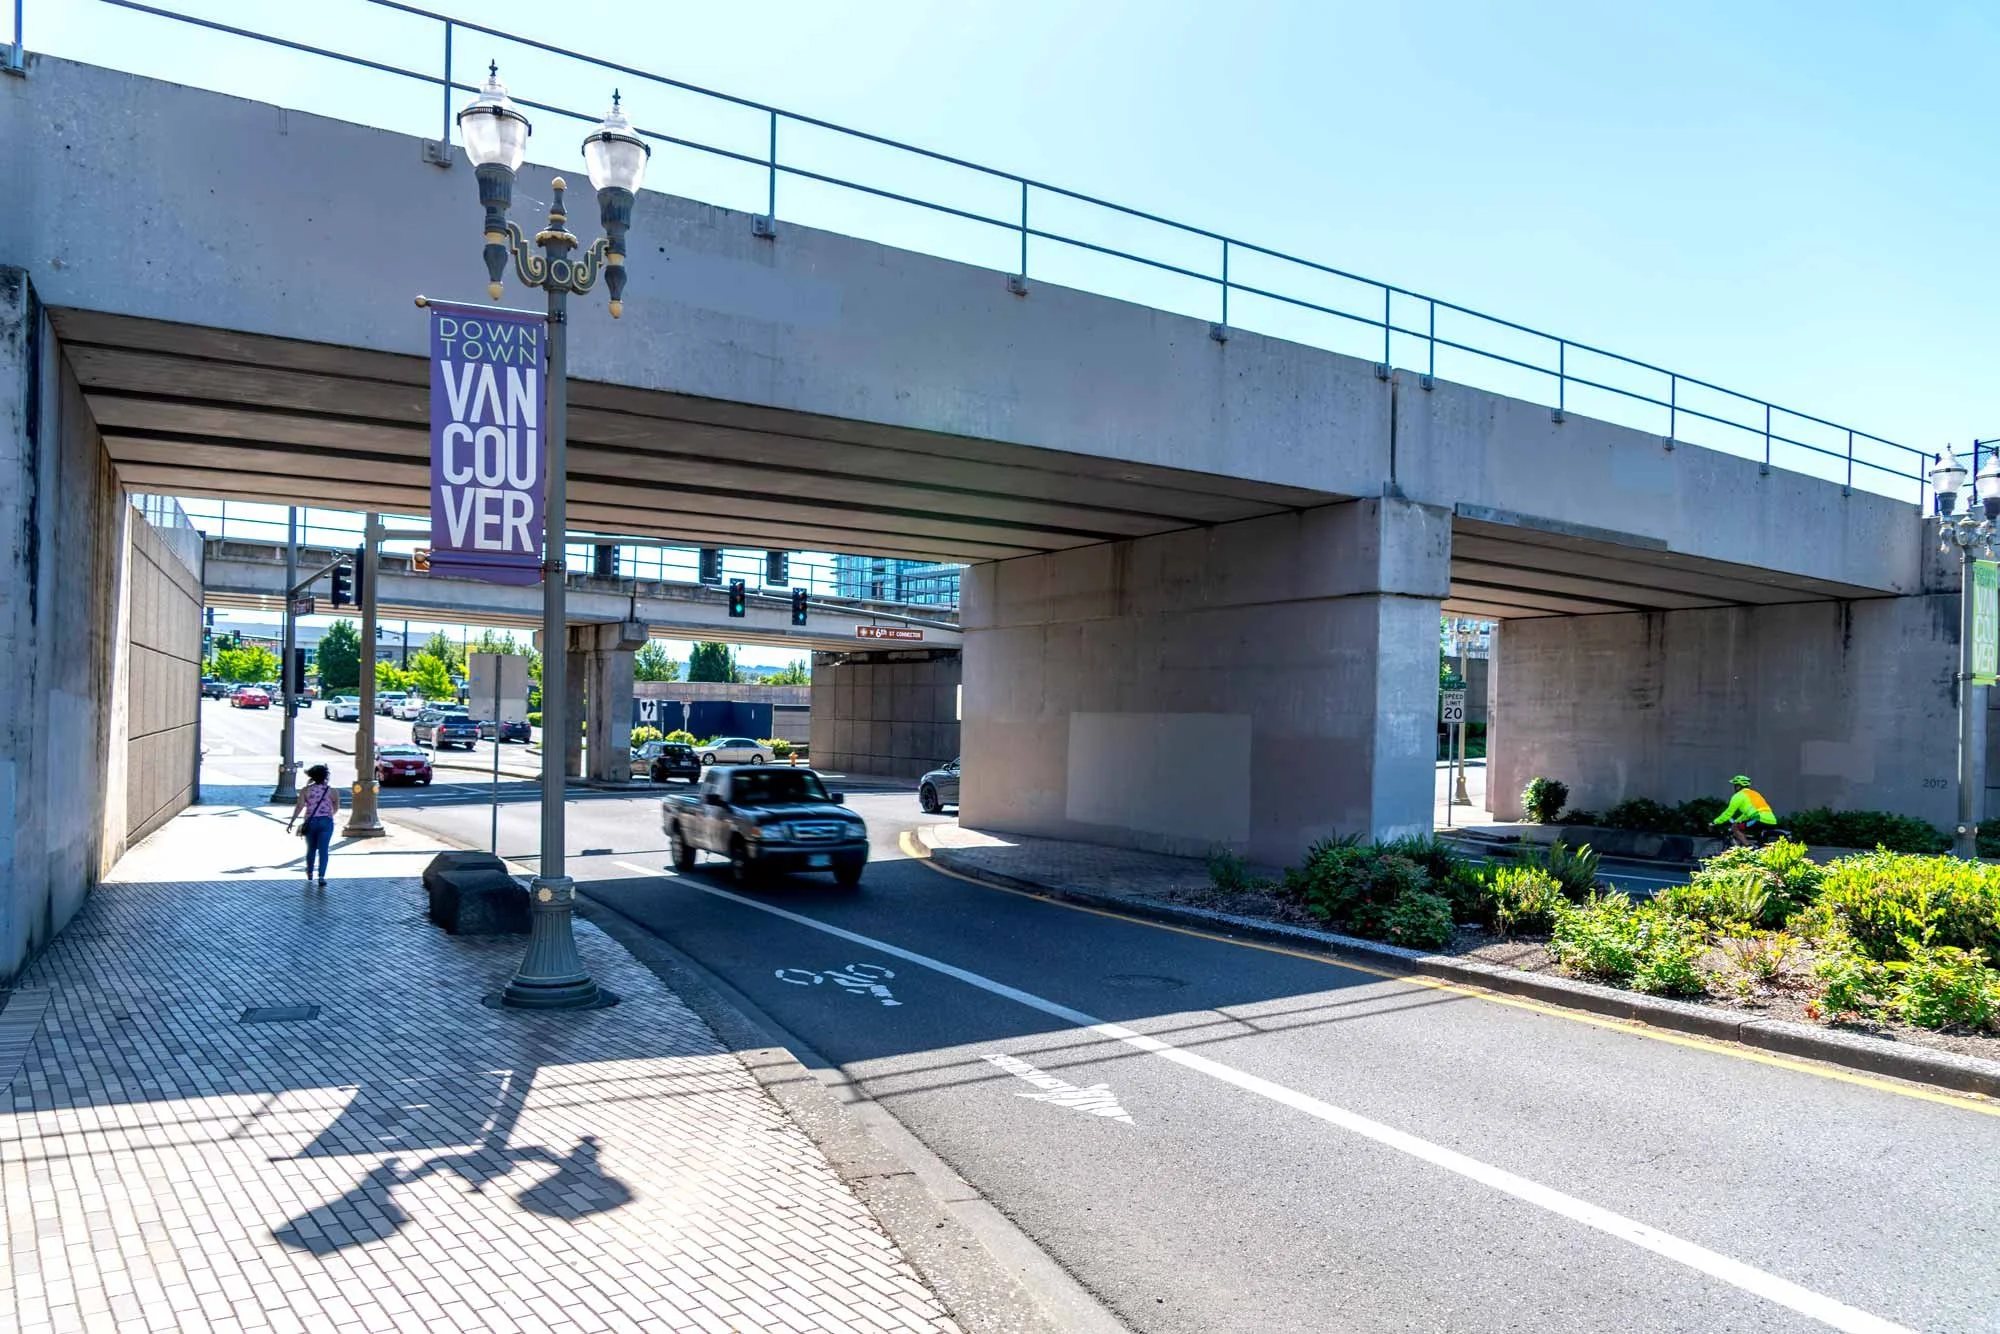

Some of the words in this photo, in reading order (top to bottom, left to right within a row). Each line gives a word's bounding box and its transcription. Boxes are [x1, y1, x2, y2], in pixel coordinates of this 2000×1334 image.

[439, 317, 537, 347] DOWN
[439, 338, 537, 366] TOWN
[440, 360, 537, 429] VAN
[442, 422, 537, 490] COU
[440, 485, 535, 552] VER
[1444, 708, 1462, 719] 20
[1922, 778, 1948, 788] 2012
